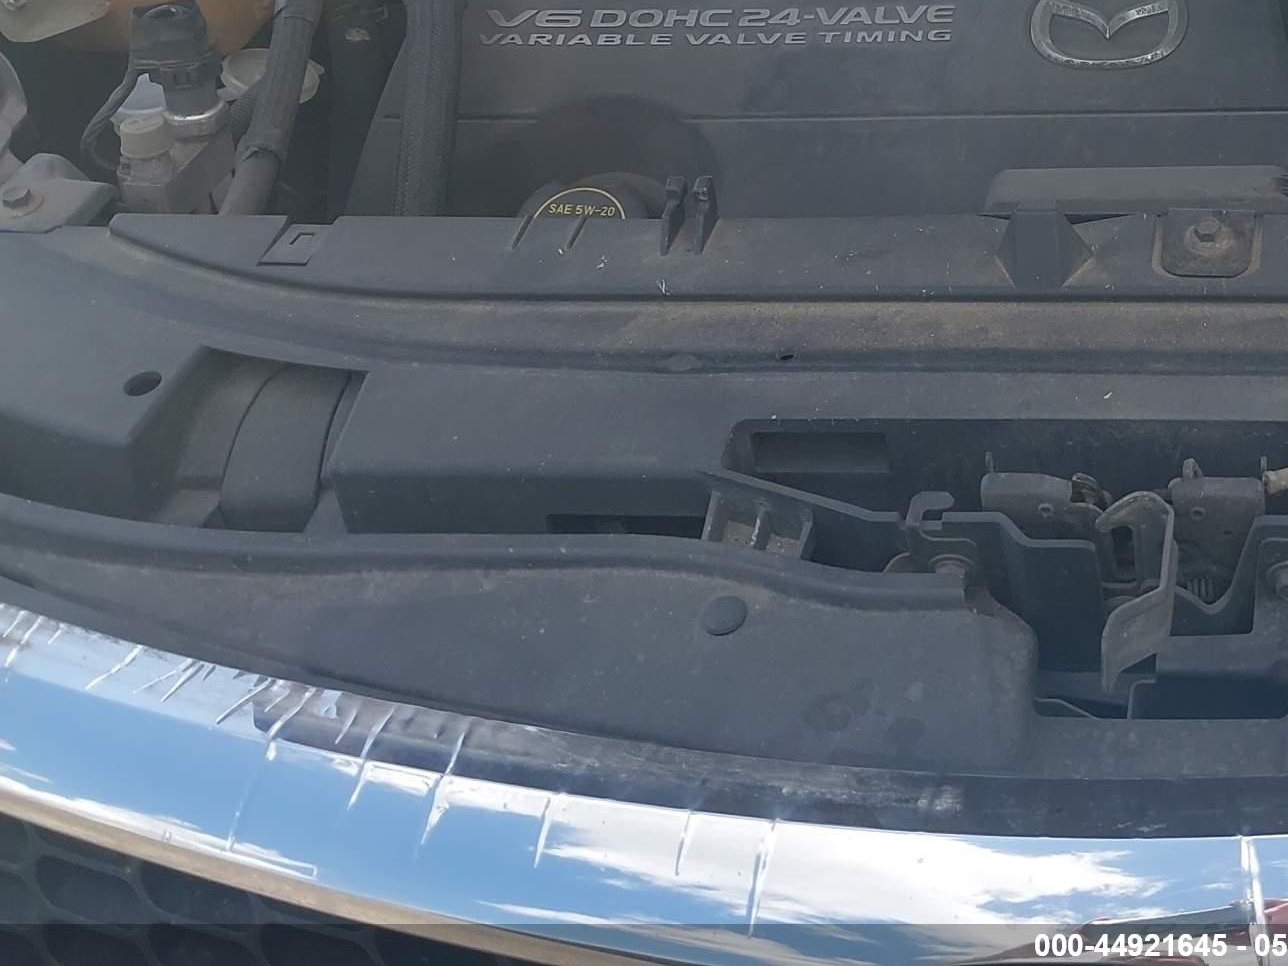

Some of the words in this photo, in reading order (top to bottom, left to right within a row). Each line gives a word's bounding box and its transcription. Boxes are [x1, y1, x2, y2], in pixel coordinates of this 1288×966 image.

[485, 9, 583, 28] V6
[590, 8, 733, 28] DOHC
[738, 4, 956, 27] 24-VALVE
[479, 33, 673, 46] VARIABLE
[685, 32, 808, 45] VALVE
[817, 29, 954, 44] TIMING
[547, 203, 573, 215] SAE
[575, 204, 616, 217] 5W-20
